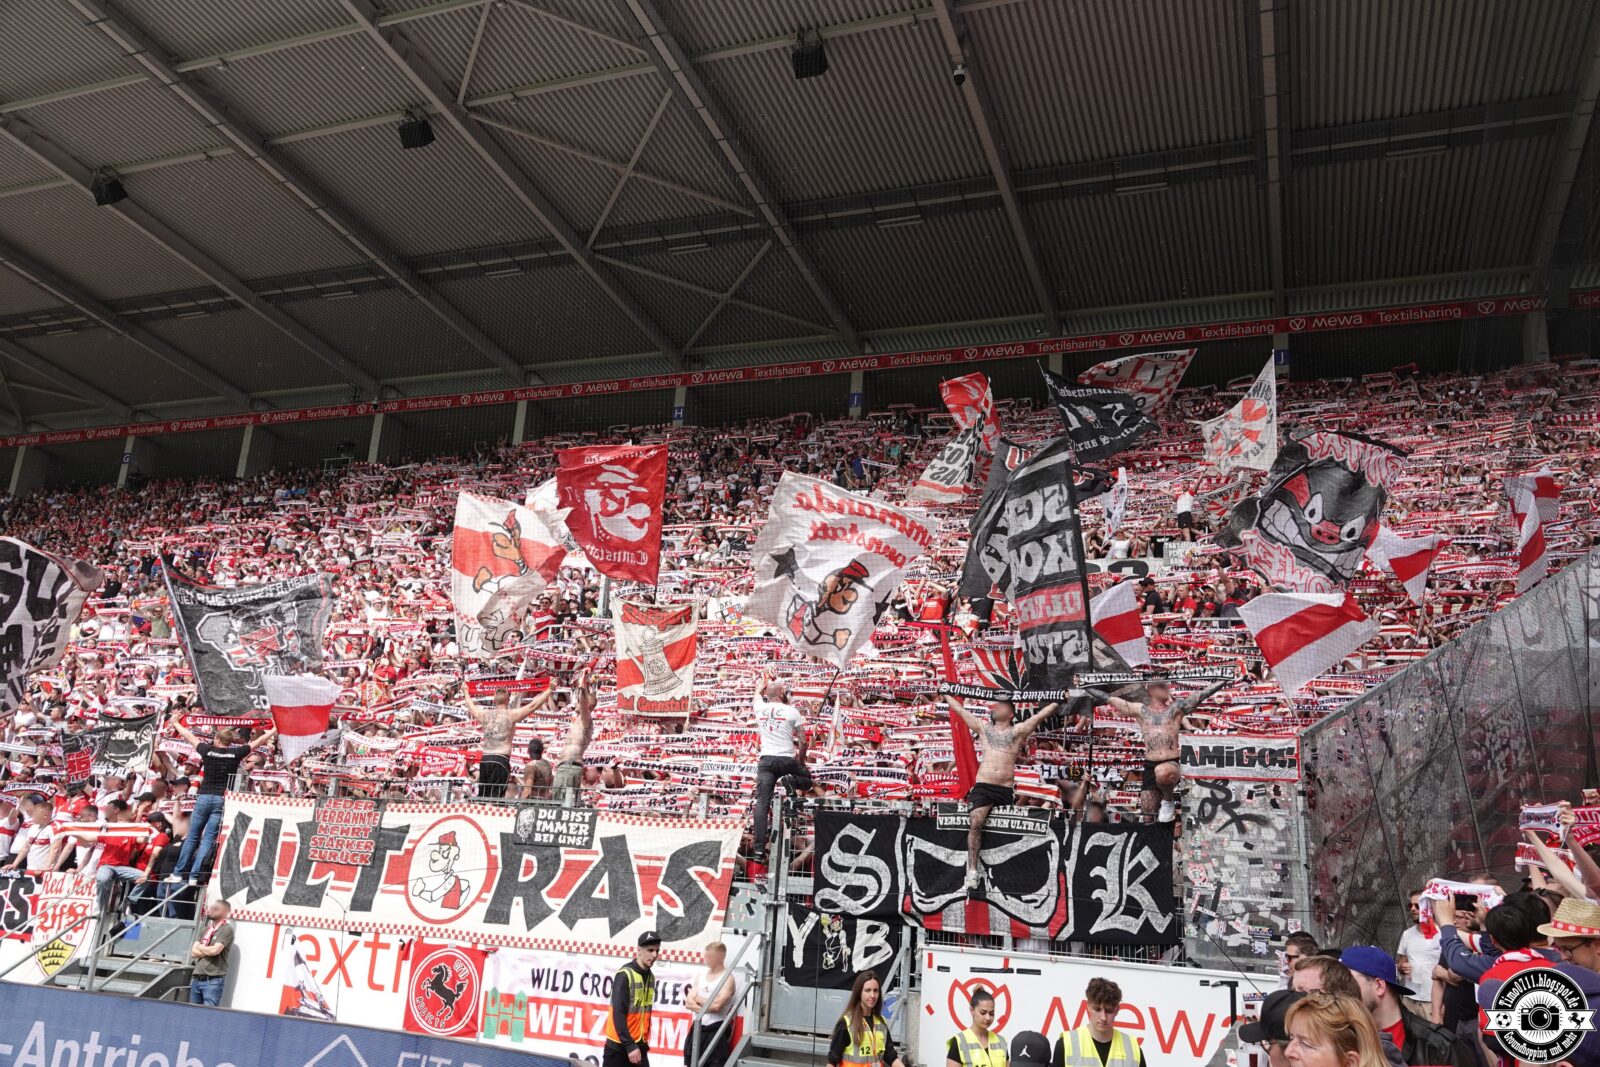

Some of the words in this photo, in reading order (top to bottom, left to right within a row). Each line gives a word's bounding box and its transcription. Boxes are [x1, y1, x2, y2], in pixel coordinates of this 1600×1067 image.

[46, 432, 80, 442] Textilsharing
[127, 424, 164, 435] Textilsharing
[214, 416, 254, 428] Textilsharing
[306, 406, 349, 418] Textilsharing
[406, 398, 452, 409] Textilsharing
[513, 387, 562, 400] Textilsharing
[629, 376, 682, 389] Textilsharing
[753, 364, 811, 378] Textilsharing
[889, 351, 952, 366] Textilsharing
[1037, 337, 1106, 353] Textilsharing
[1200, 321, 1275, 338] Textilsharing
[1378, 306, 1461, 323] Textilsharing
[674, 408, 683, 418] H
[1167, 665, 1234, 680] KOMPANIE
[939, 682, 993, 699] Schwaben
[324, 798, 376, 811] JEDER
[315, 807, 381, 827] VERBANNTE
[538, 808, 558, 820] DU
[561, 810, 593, 823] BIST
[317, 823, 373, 839] KEHRT
[536, 820, 590, 836] IMMER
[1010, 819, 1047, 833] ULTRAS
[534, 832, 555, 843] BEI
[558, 834, 590, 846] UNS!
[531, 967, 574, 993] WILD
[528, 1002, 689, 1050] WELZIM
[859, 1046, 871, 1056] 12
